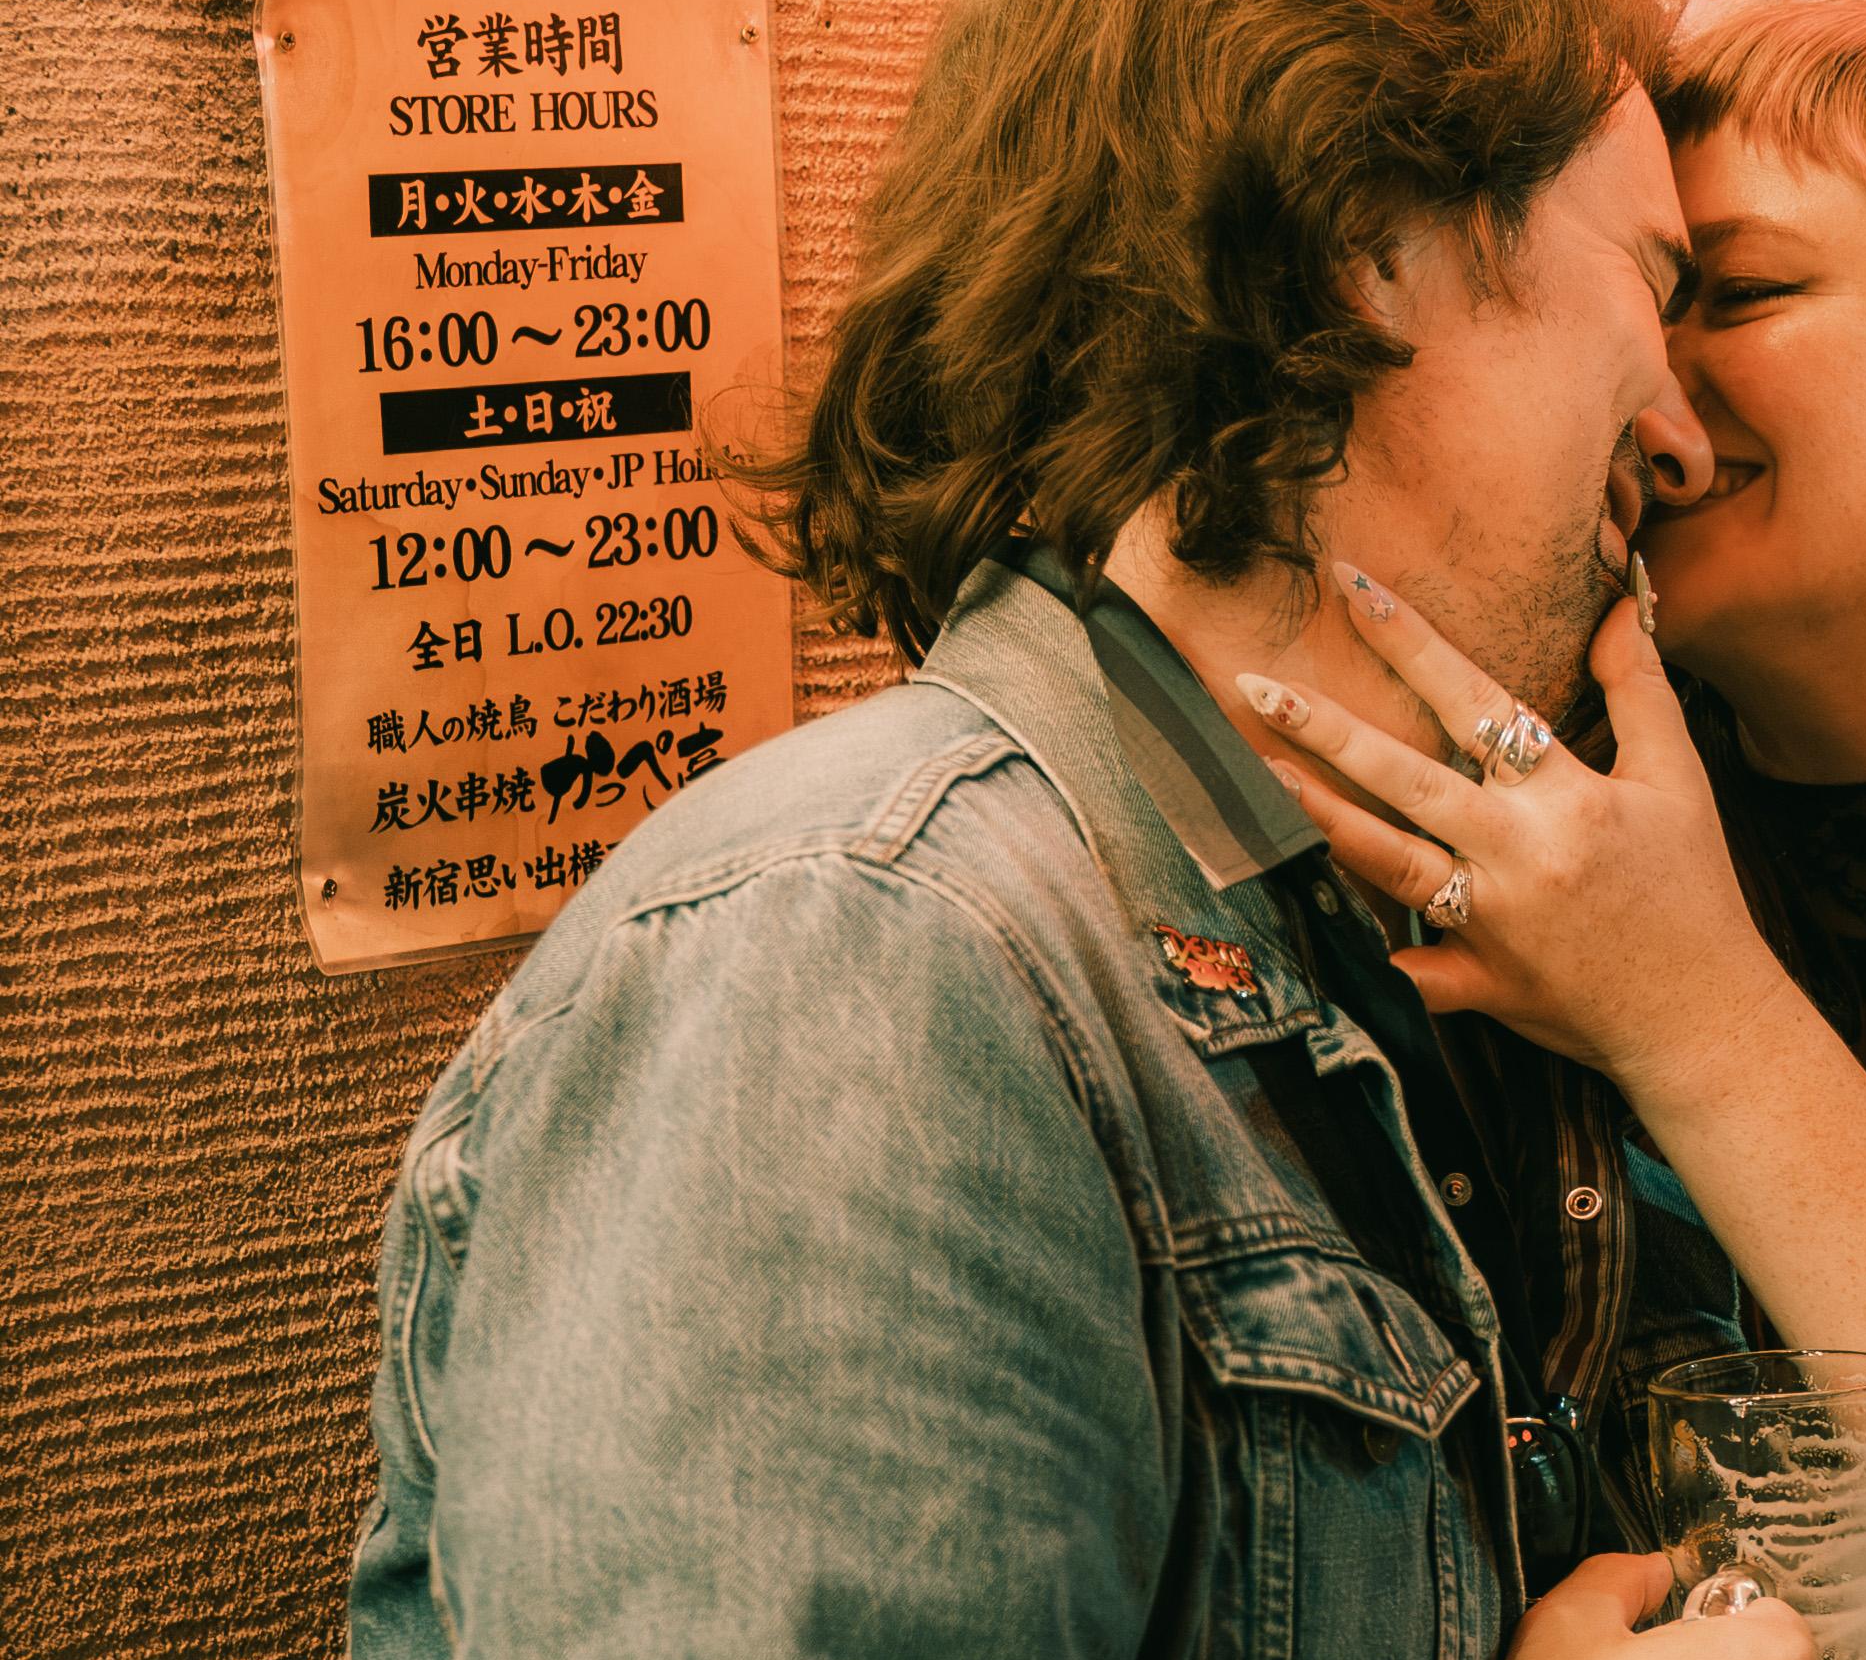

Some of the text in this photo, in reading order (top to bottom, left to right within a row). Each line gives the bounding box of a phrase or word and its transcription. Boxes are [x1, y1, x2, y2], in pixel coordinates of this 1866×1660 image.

[416, 10, 624, 80] 営業時間
[389, 89, 660, 136] STORE HOURS
[414, 243, 649, 290] Monday-Friday
[406, 595, 693, 672] 全日 L.O. 22:30
[366, 670, 728, 755] 職人の焼鳥 こだわり酒場
[368, 766, 537, 834] 炭火串焼
[384, 839, 623, 912] 新宿思い出横
